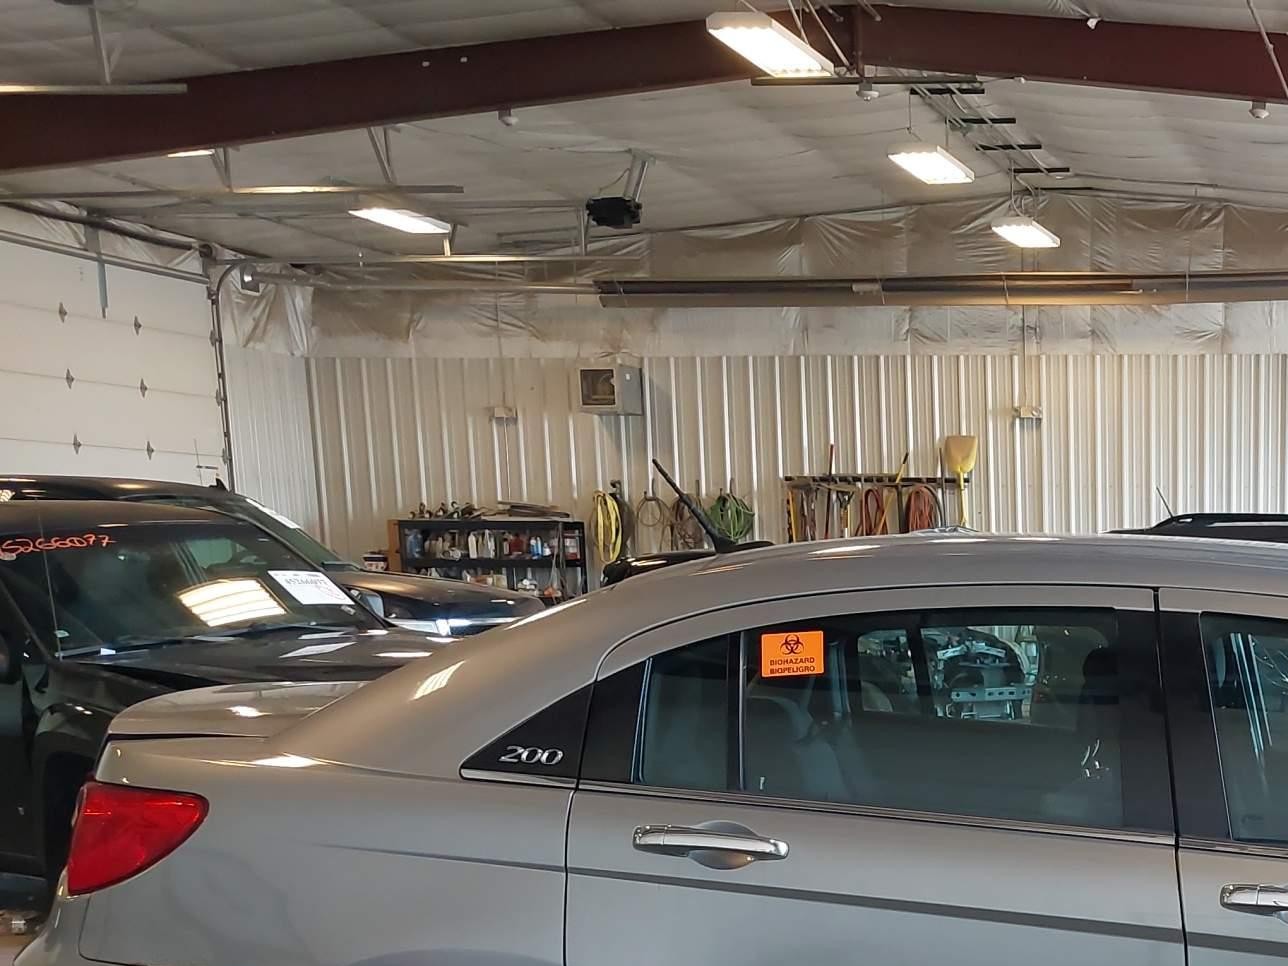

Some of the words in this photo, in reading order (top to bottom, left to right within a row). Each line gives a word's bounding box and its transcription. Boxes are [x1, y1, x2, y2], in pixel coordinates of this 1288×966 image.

[769, 656, 815, 666] BIOHAZARD
[769, 665, 816, 675] BIOPELIGRO
[498, 745, 564, 765] 200
